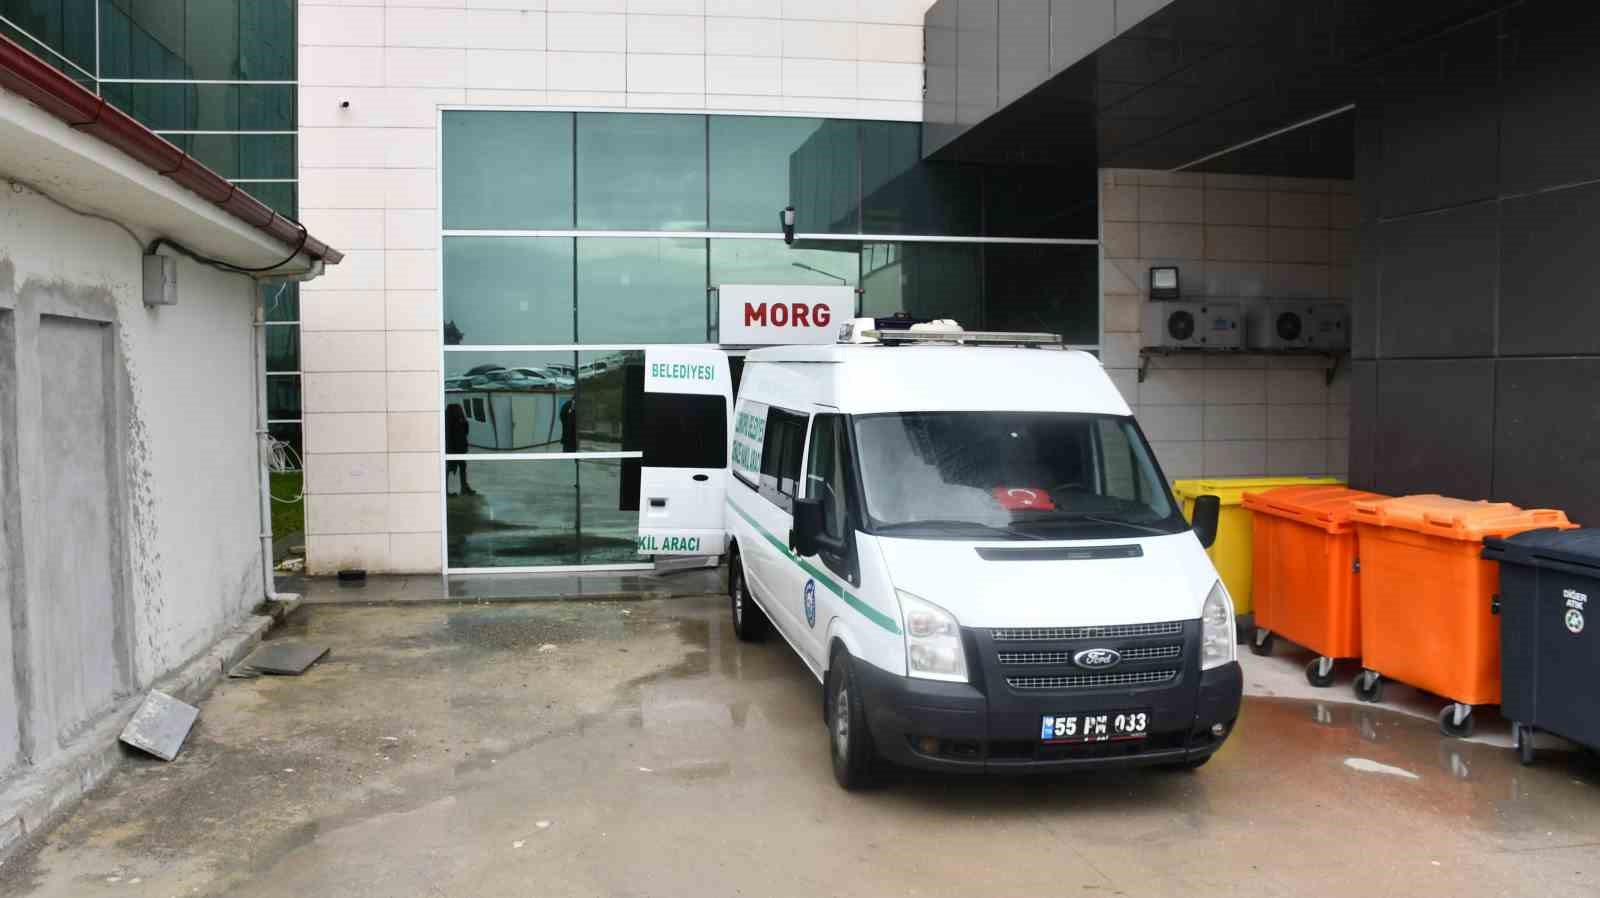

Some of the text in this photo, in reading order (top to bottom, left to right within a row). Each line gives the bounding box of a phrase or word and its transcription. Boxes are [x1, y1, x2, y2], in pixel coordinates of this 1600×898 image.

[744, 302, 831, 327] MORG
[662, 536, 701, 552] ARACI
[1086, 651, 1112, 664] Ford
[1055, 717, 1077, 736] 55
